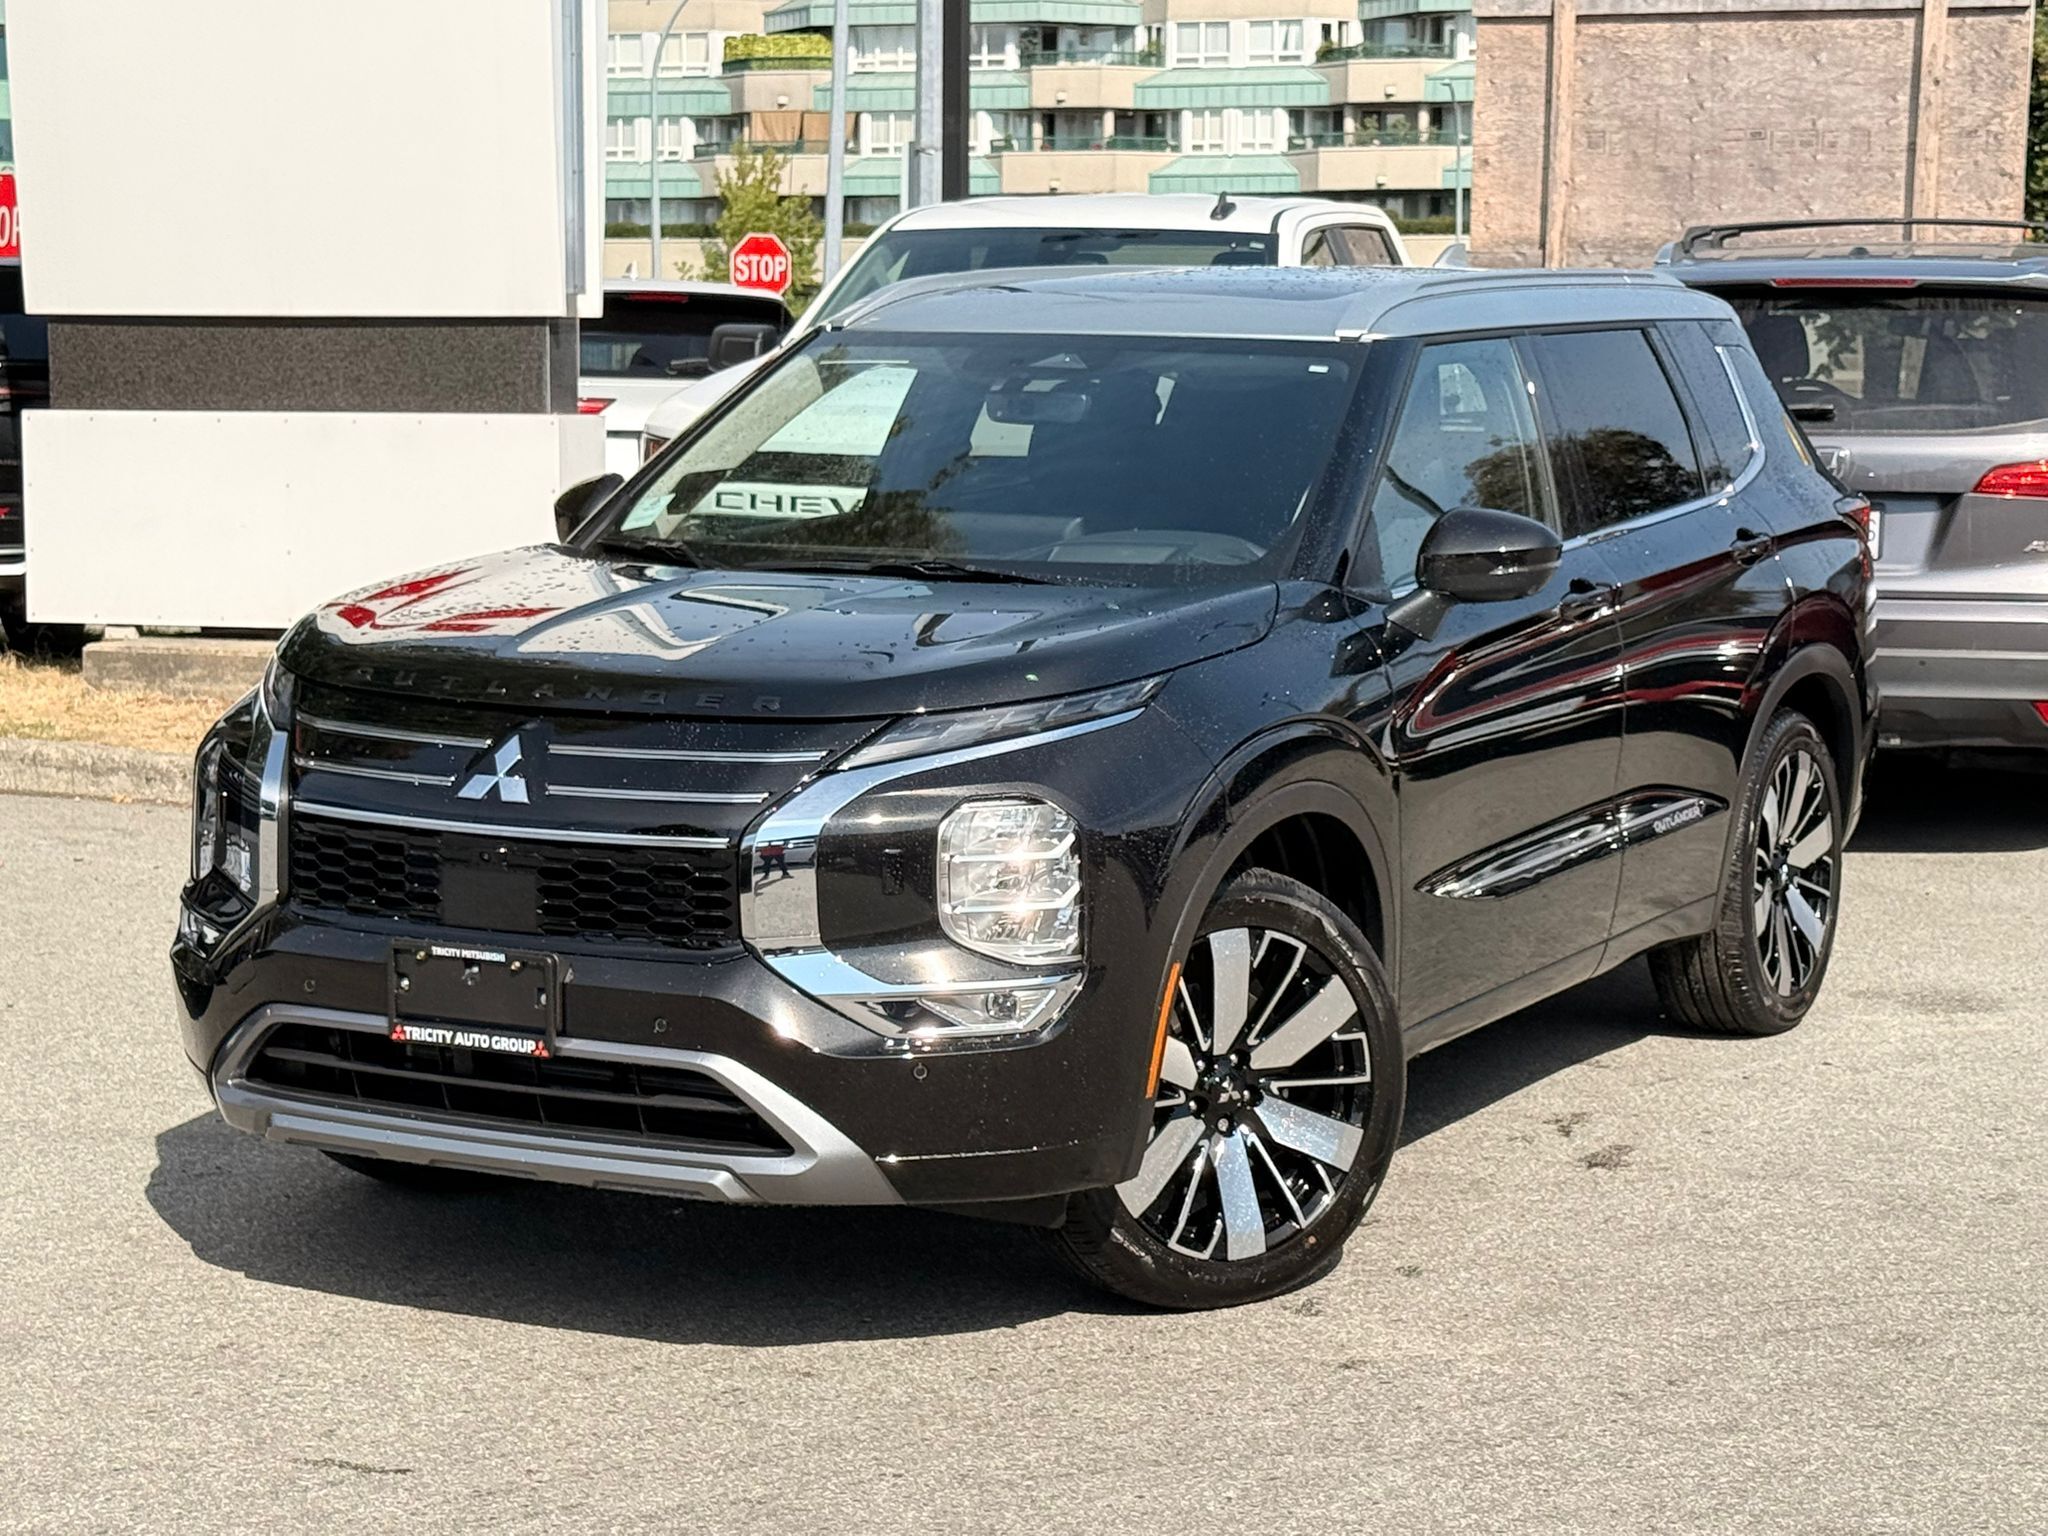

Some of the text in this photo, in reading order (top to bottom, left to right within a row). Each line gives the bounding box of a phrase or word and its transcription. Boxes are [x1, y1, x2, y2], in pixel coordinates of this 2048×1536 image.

[735, 253, 787, 283] STOP
[356, 667, 783, 712] OUTLANDER
[431, 946, 506, 963] TRICITY MITSUBISHI
[403, 1025, 537, 1054] TRICITY AUTO GROUP
